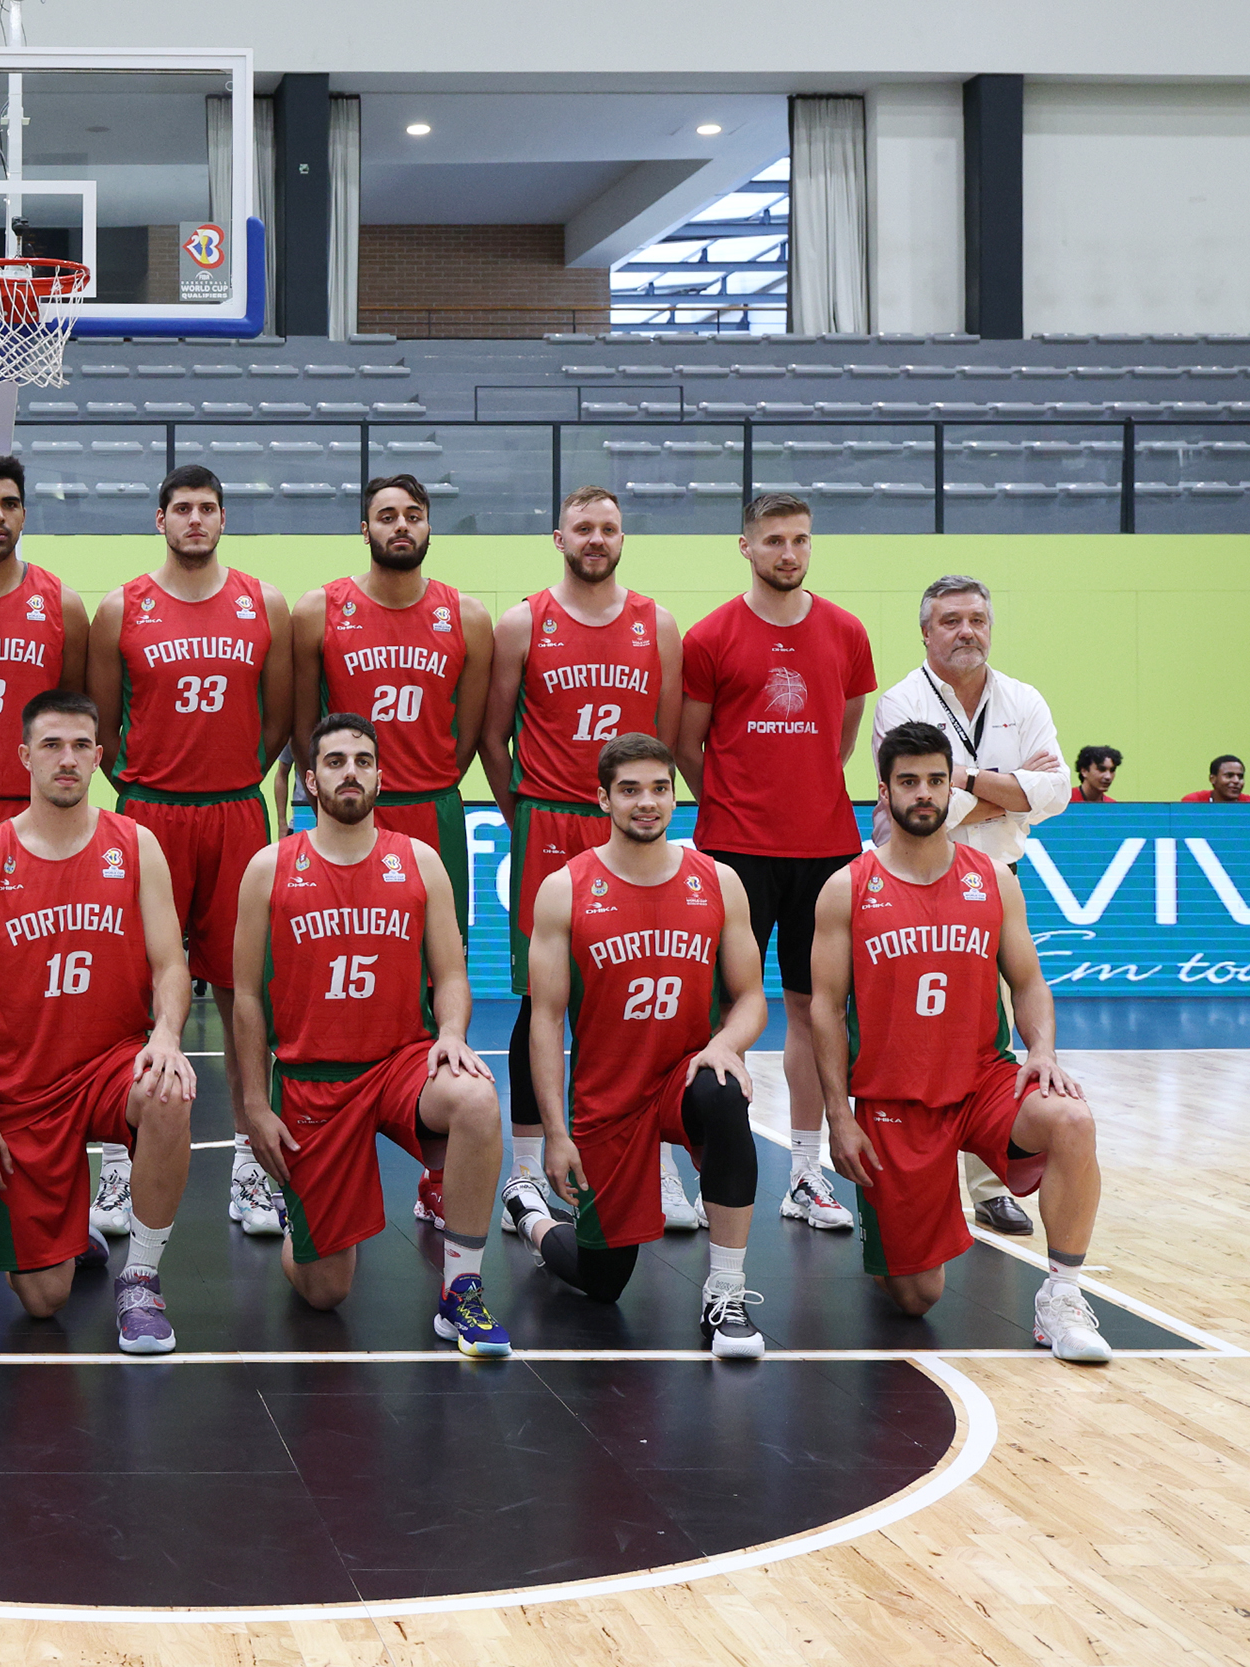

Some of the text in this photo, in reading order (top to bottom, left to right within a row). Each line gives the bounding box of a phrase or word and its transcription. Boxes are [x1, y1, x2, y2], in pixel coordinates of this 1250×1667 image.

[181, 285, 229, 293] WORLD CUP
[181, 292, 228, 300] QUALIFIERS
[143, 636, 255, 668] PORTUGAL
[343, 645, 448, 679] PORTUGAL
[175, 674, 228, 714] 33
[542, 663, 649, 695] PORTUGAL
[370, 684, 424, 722] 20
[571, 703, 622, 742] 12
[747, 720, 819, 734] PORTUGAL
[585, 906, 618, 915] DHIKA
[861, 901, 892, 910] DHIKA
[5, 903, 125, 947] PORTUGAL
[289, 907, 410, 945] PORTUGAL
[588, 929, 712, 970] PORTUGAL
[864, 924, 990, 965] PORTUGAL
[44, 950, 93, 998] 16
[324, 954, 379, 1000] 15
[623, 976, 683, 1021] 28
[915, 971, 948, 1017] 6
